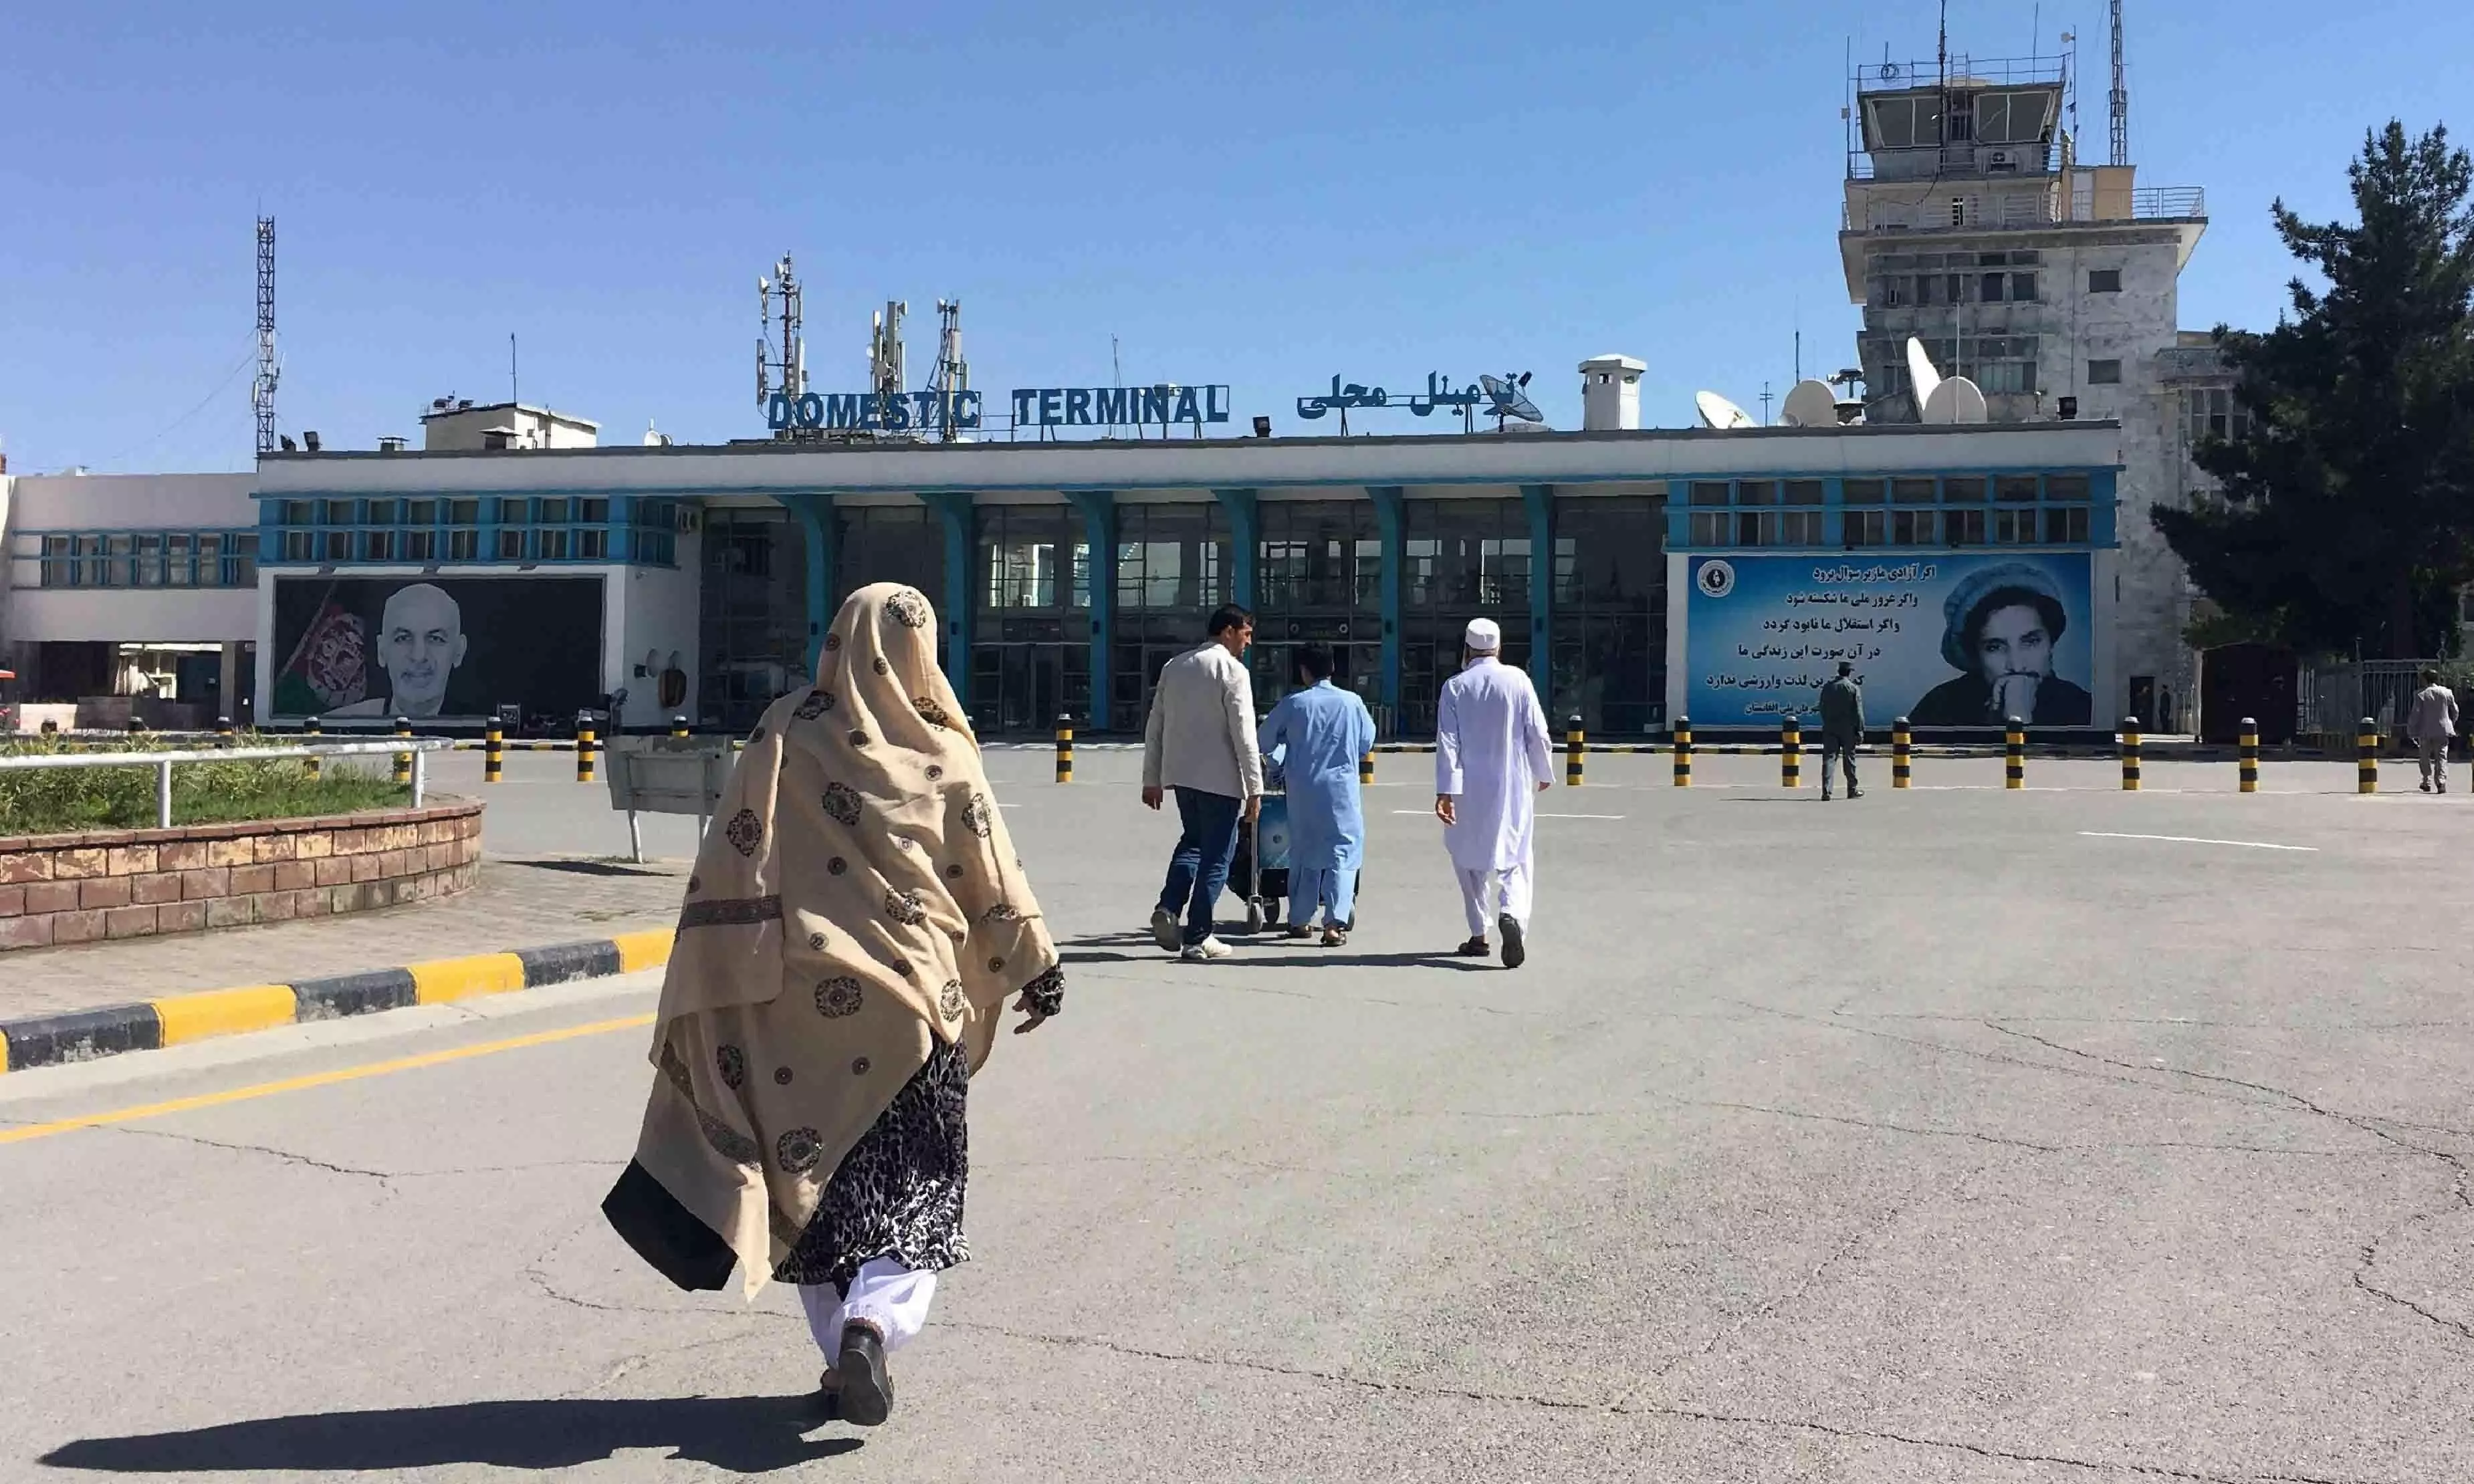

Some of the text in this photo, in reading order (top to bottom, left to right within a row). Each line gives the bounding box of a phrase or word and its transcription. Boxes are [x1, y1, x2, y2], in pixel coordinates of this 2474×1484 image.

[1297, 374, 1387, 419] محلی
[768, 384, 1228, 429] DOMESTIC TERMINAL
[1839, 592, 1849, 603] ما
[1850, 592, 1870, 607] ملی
[1872, 594, 1896, 608] غرور
[1793, 617, 1819, 632] نابود
[1821, 618, 1831, 629] ما
[1834, 617, 1874, 632] استقلال
[1738, 644, 1749, 656] ما
[1790, 644, 1808, 659] این
[1811, 645, 1844, 660] صورت
[1847, 643, 1864, 659] آن
[1868, 646, 1881, 659] در
[1706, 674, 1736, 689] ندارد
[1783, 674, 1807, 686] لذت
[1779, 703, 1794, 715] ملی
